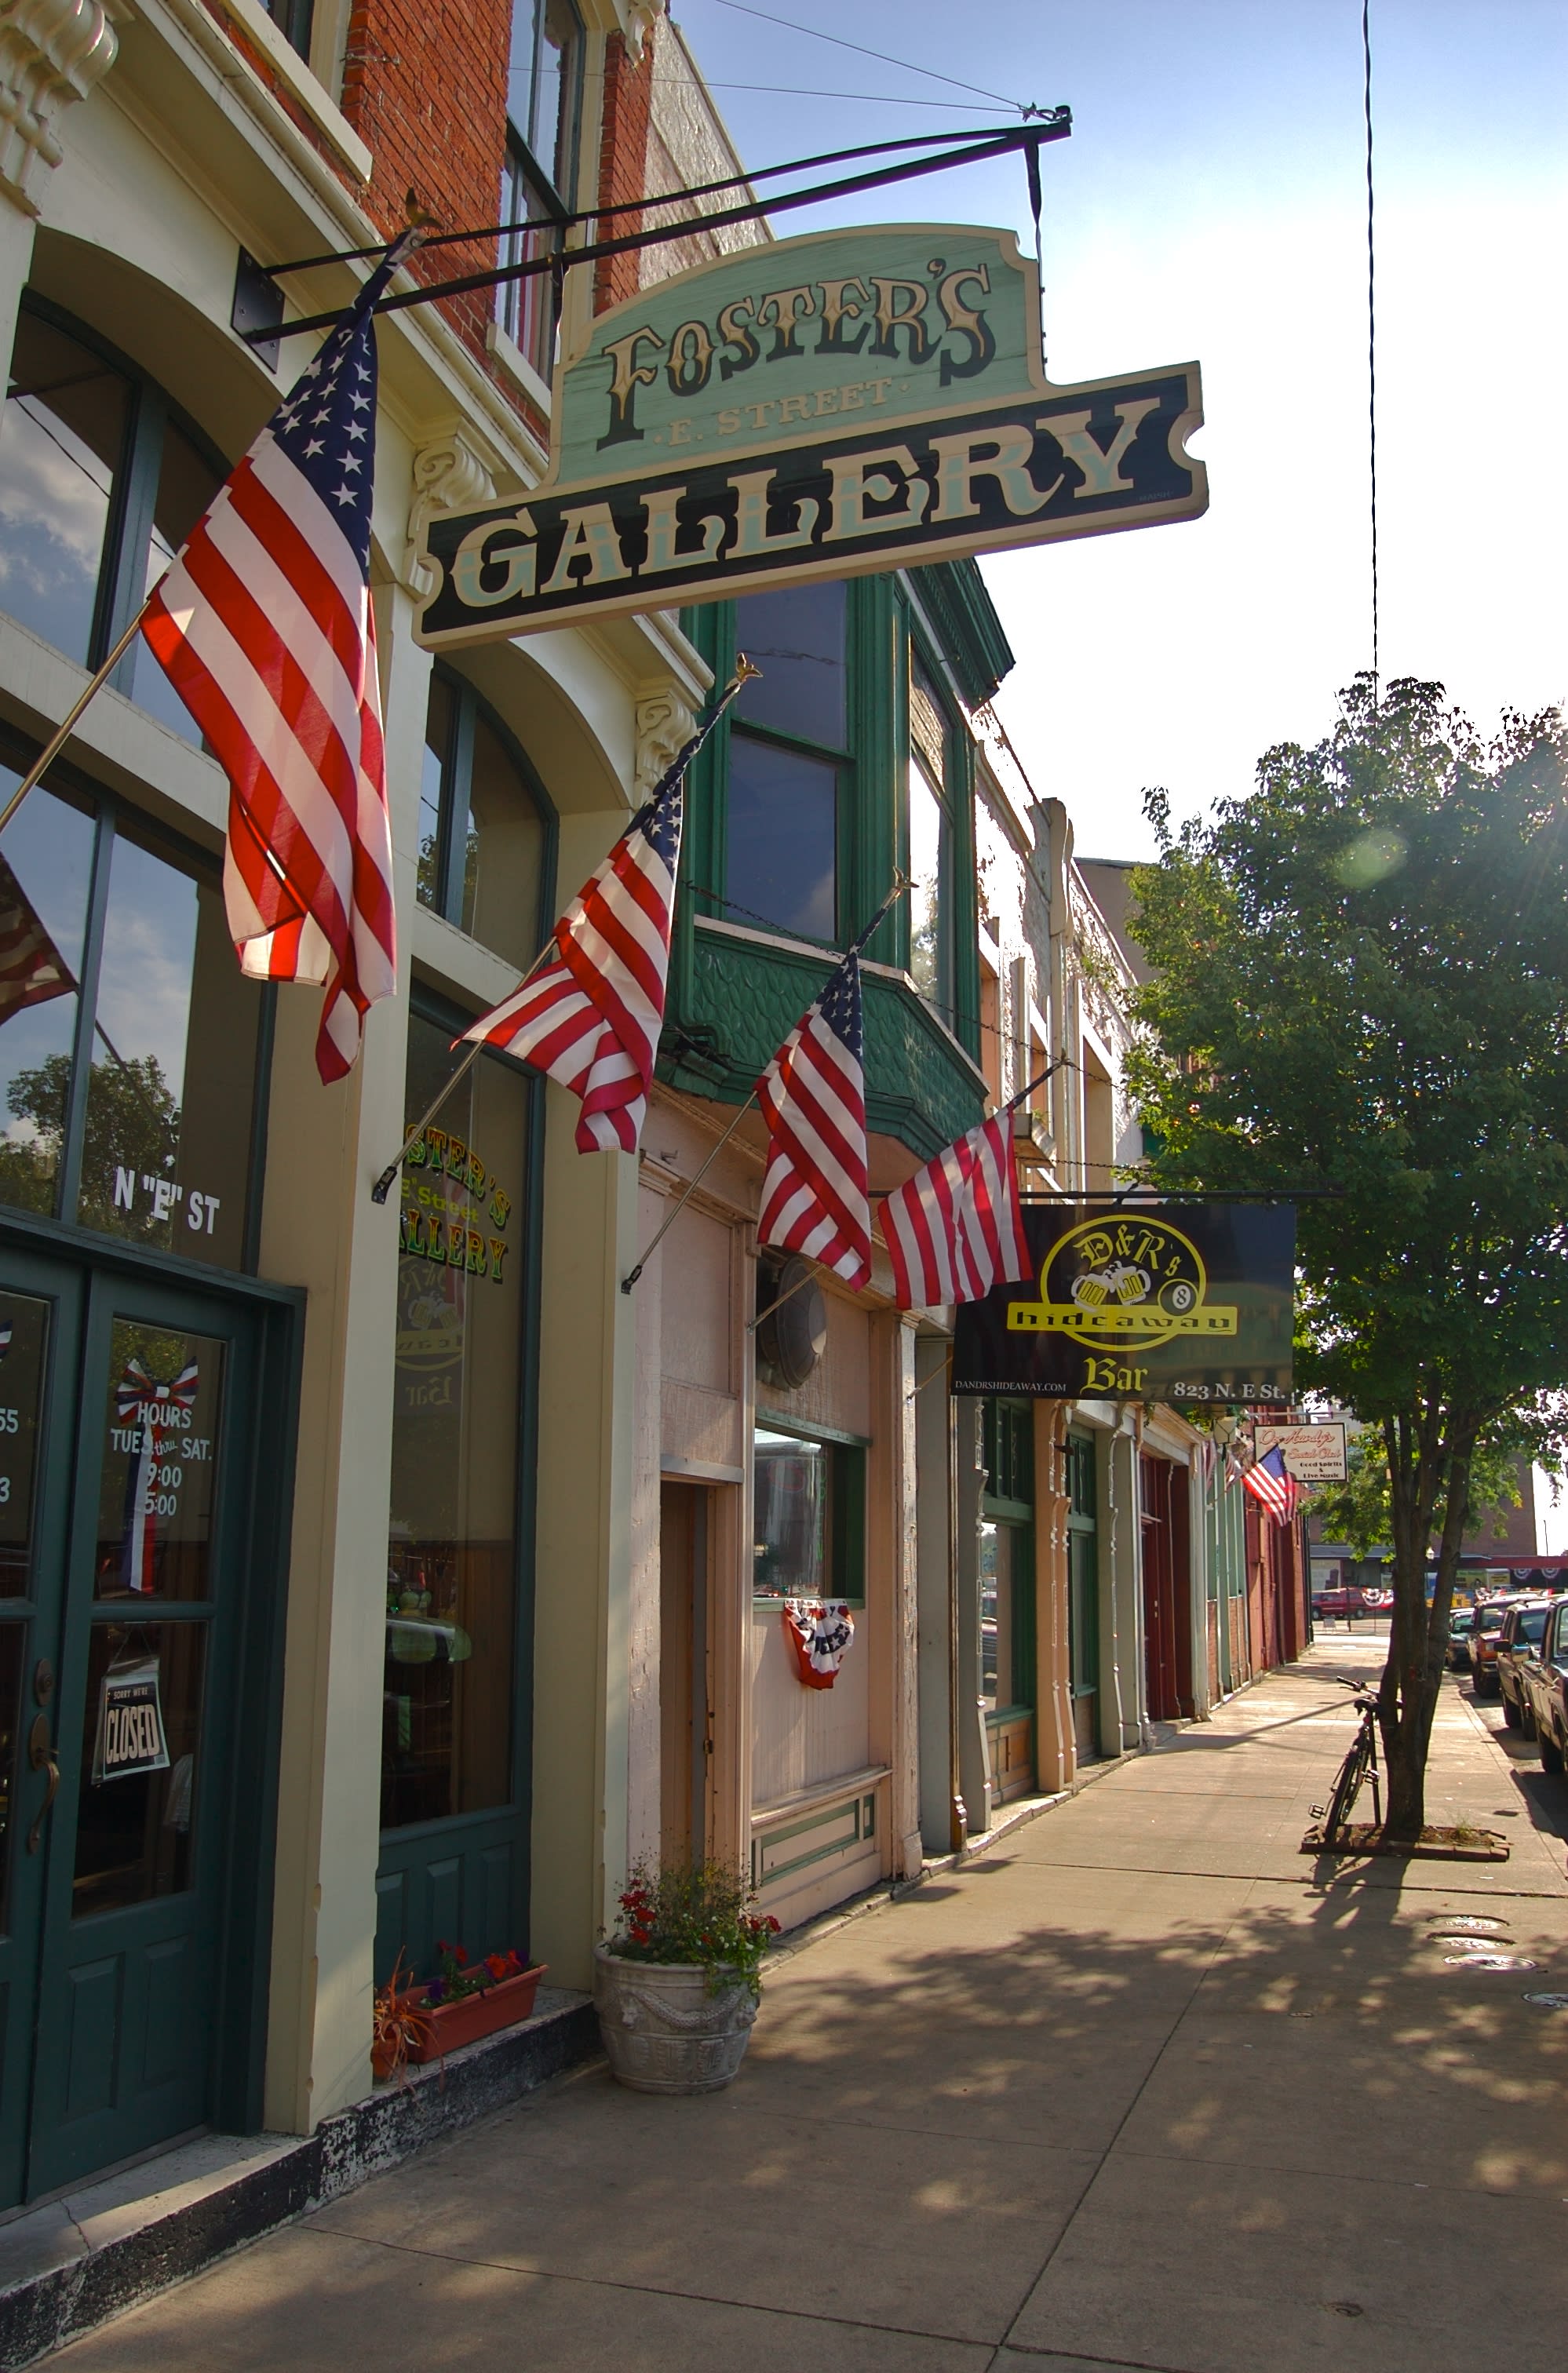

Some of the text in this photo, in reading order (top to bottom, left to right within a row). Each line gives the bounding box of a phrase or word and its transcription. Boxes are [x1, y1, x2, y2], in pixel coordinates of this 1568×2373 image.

[596, 258, 996, 452] FOSTER'S
[717, 376, 892, 438] STREET
[448, 397, 1161, 607] GALLERY
[114, 1165, 136, 1210] N
[188, 1190, 221, 1235] ST
[418, 1186, 479, 1224] Street
[399, 1208, 507, 1279] LLERY
[955, 1380, 1067, 1392] DANDRSHIDEAWAY.COM
[1079, 1356, 1148, 1394] Bar
[1173, 1382, 1285, 1400] 823 N. E St.
[137, 1401, 193, 1429] HOURS
[154, 1439, 178, 1456] thru
[181, 1437, 212, 1461] SAT.
[148, 1462, 182, 1489] 9:00
[144, 1491, 177, 1516] 5:00
[113, 1689, 131, 1700] SORRY
[106, 1704, 160, 1765] CLOSED
